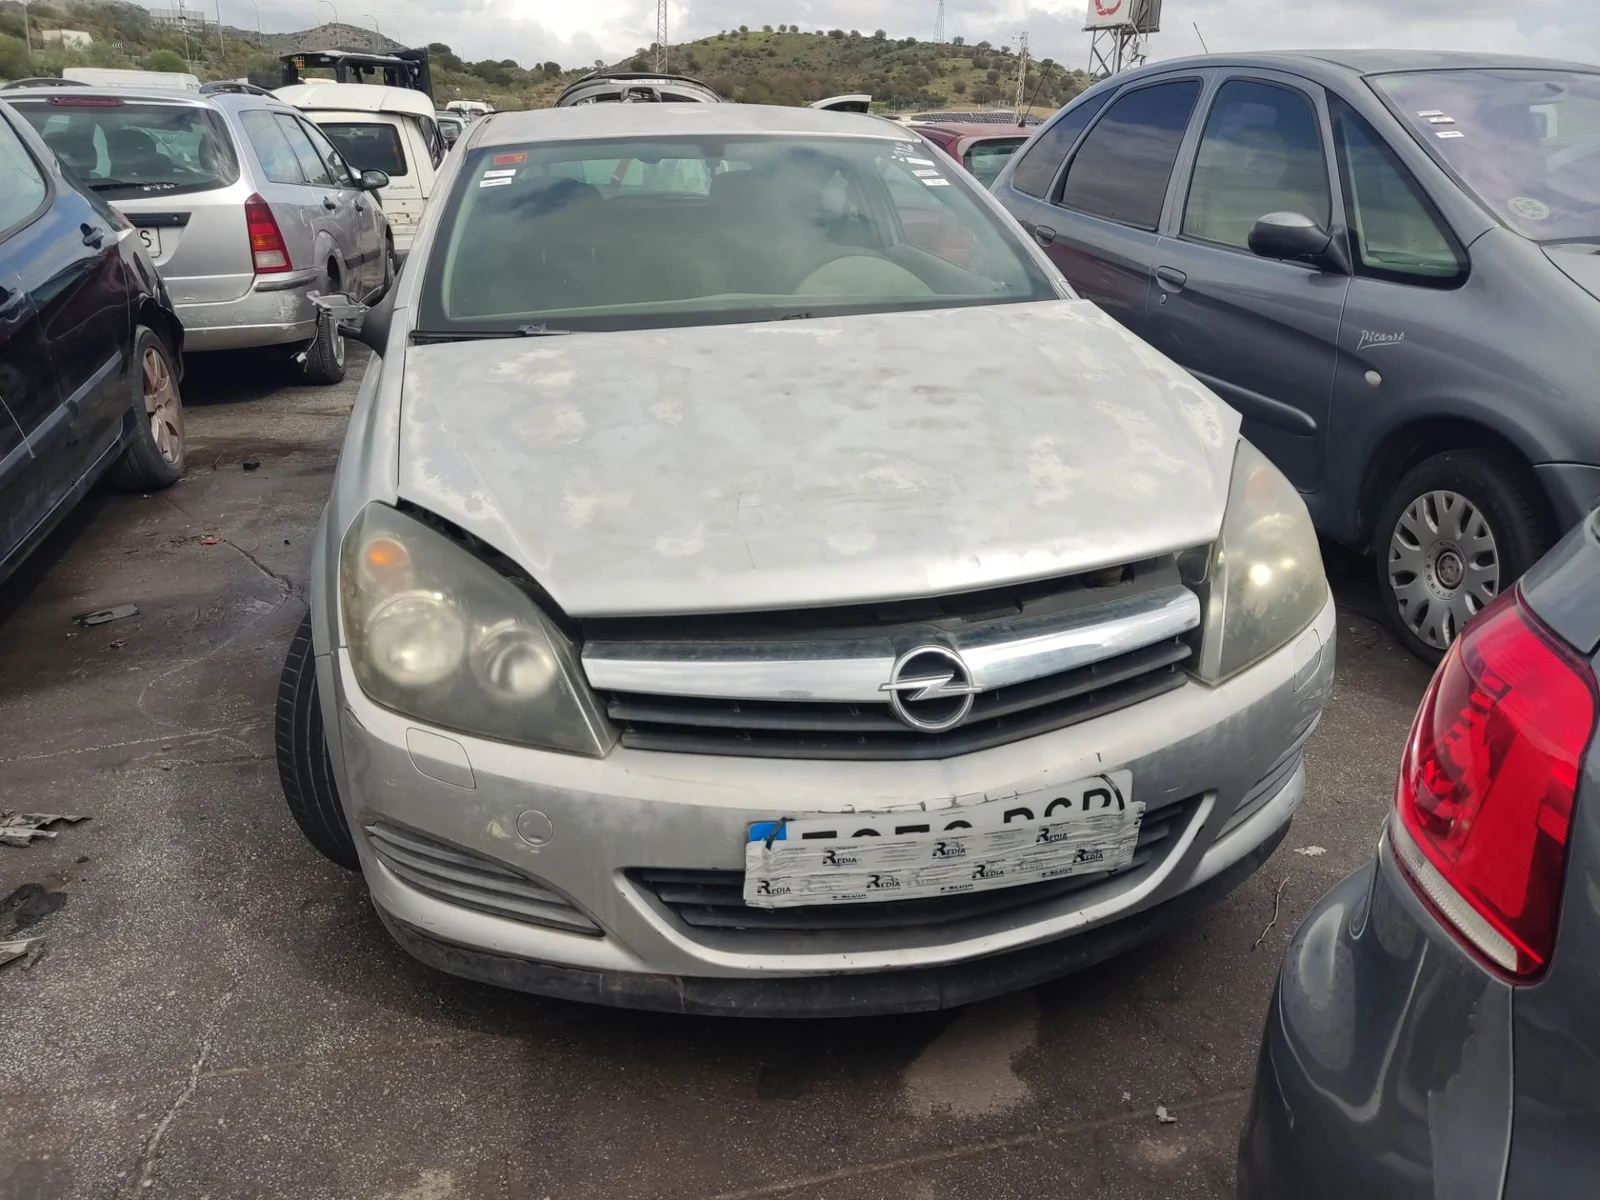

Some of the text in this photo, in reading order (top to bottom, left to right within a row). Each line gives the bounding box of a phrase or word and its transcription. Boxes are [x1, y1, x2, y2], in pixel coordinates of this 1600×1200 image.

[1356, 330, 1404, 352] Picasso
[932, 842, 966, 857] REDIA
[1073, 849, 1104, 863] REDIA
[822, 850, 858, 865] REDIA
[757, 880, 792, 894] REDIA
[866, 875, 901, 888] REDIA
